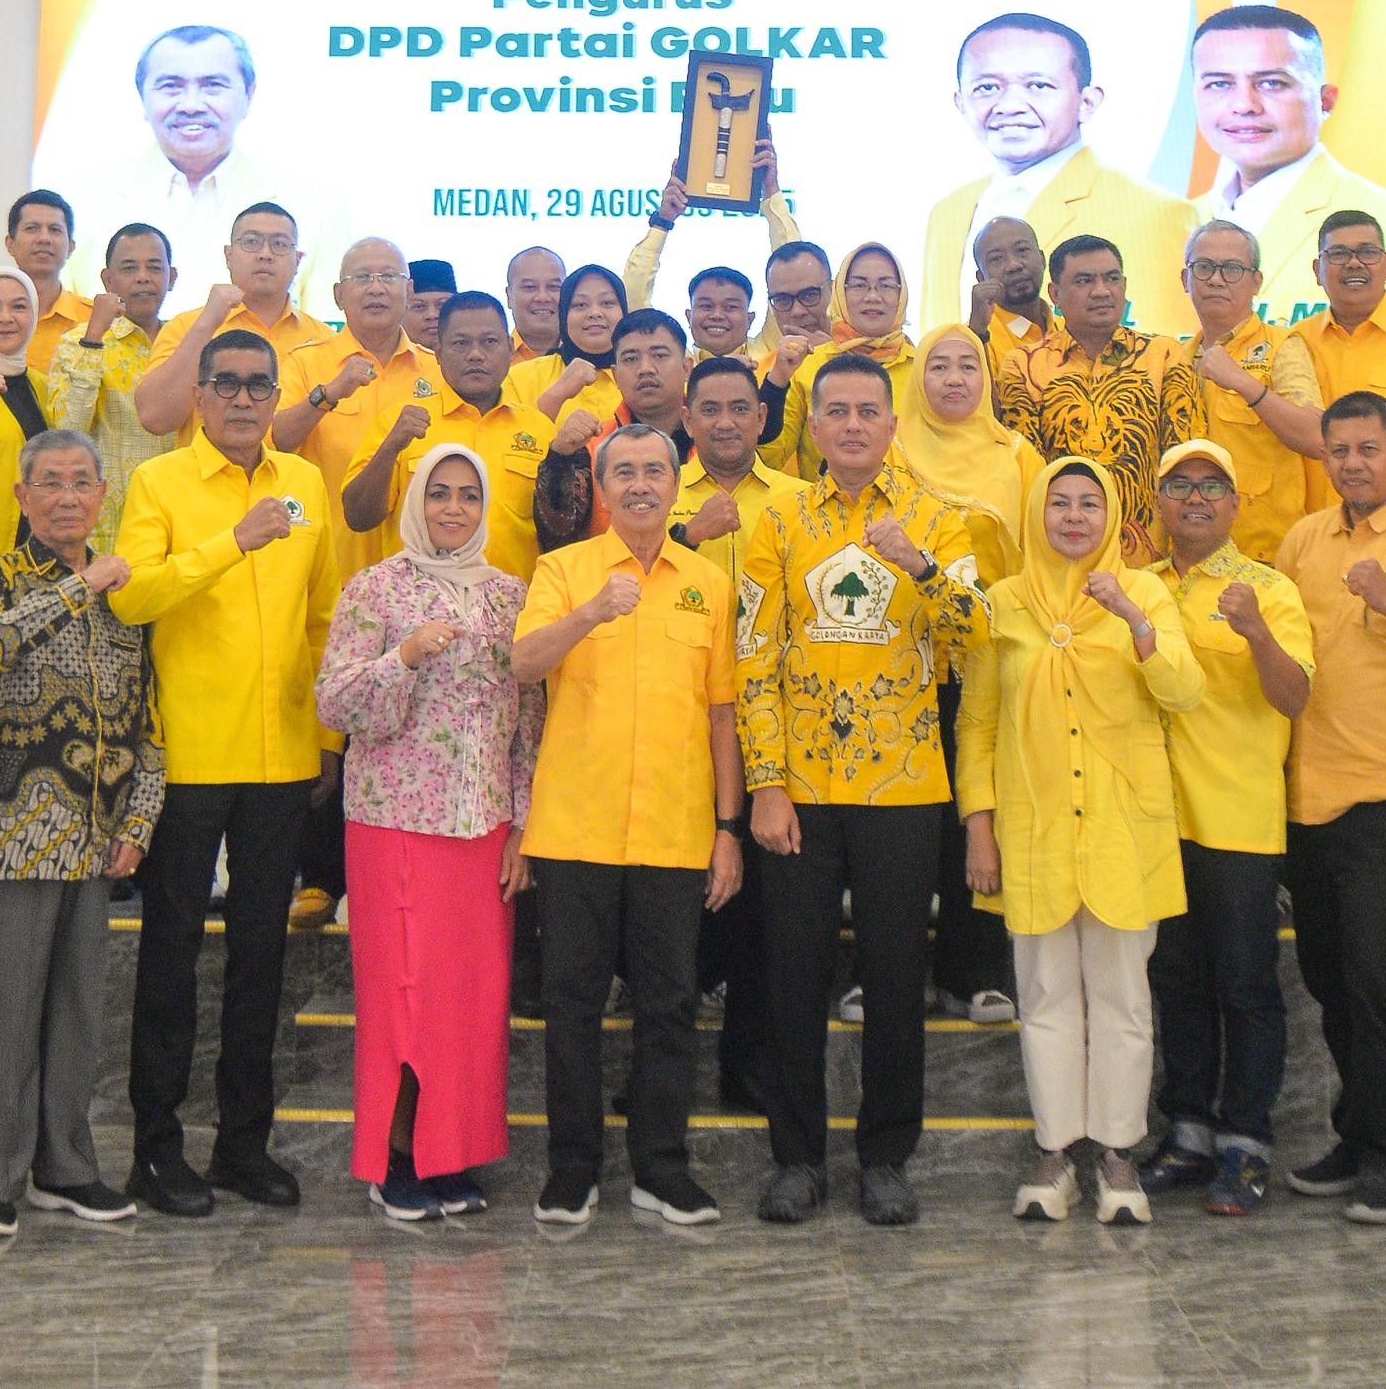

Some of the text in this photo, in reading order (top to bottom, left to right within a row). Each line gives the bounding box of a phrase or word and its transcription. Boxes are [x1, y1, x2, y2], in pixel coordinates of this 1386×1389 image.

[329, 23, 888, 59] DPD Partai GOLKAR
[430, 76, 656, 113] Provinsi
[433, 188, 539, 220] MEDAN,
[547, 188, 582, 217] 29
[590, 188, 713, 217] AGUS
[810, 630, 886, 641] GOLONGAN KARYA
